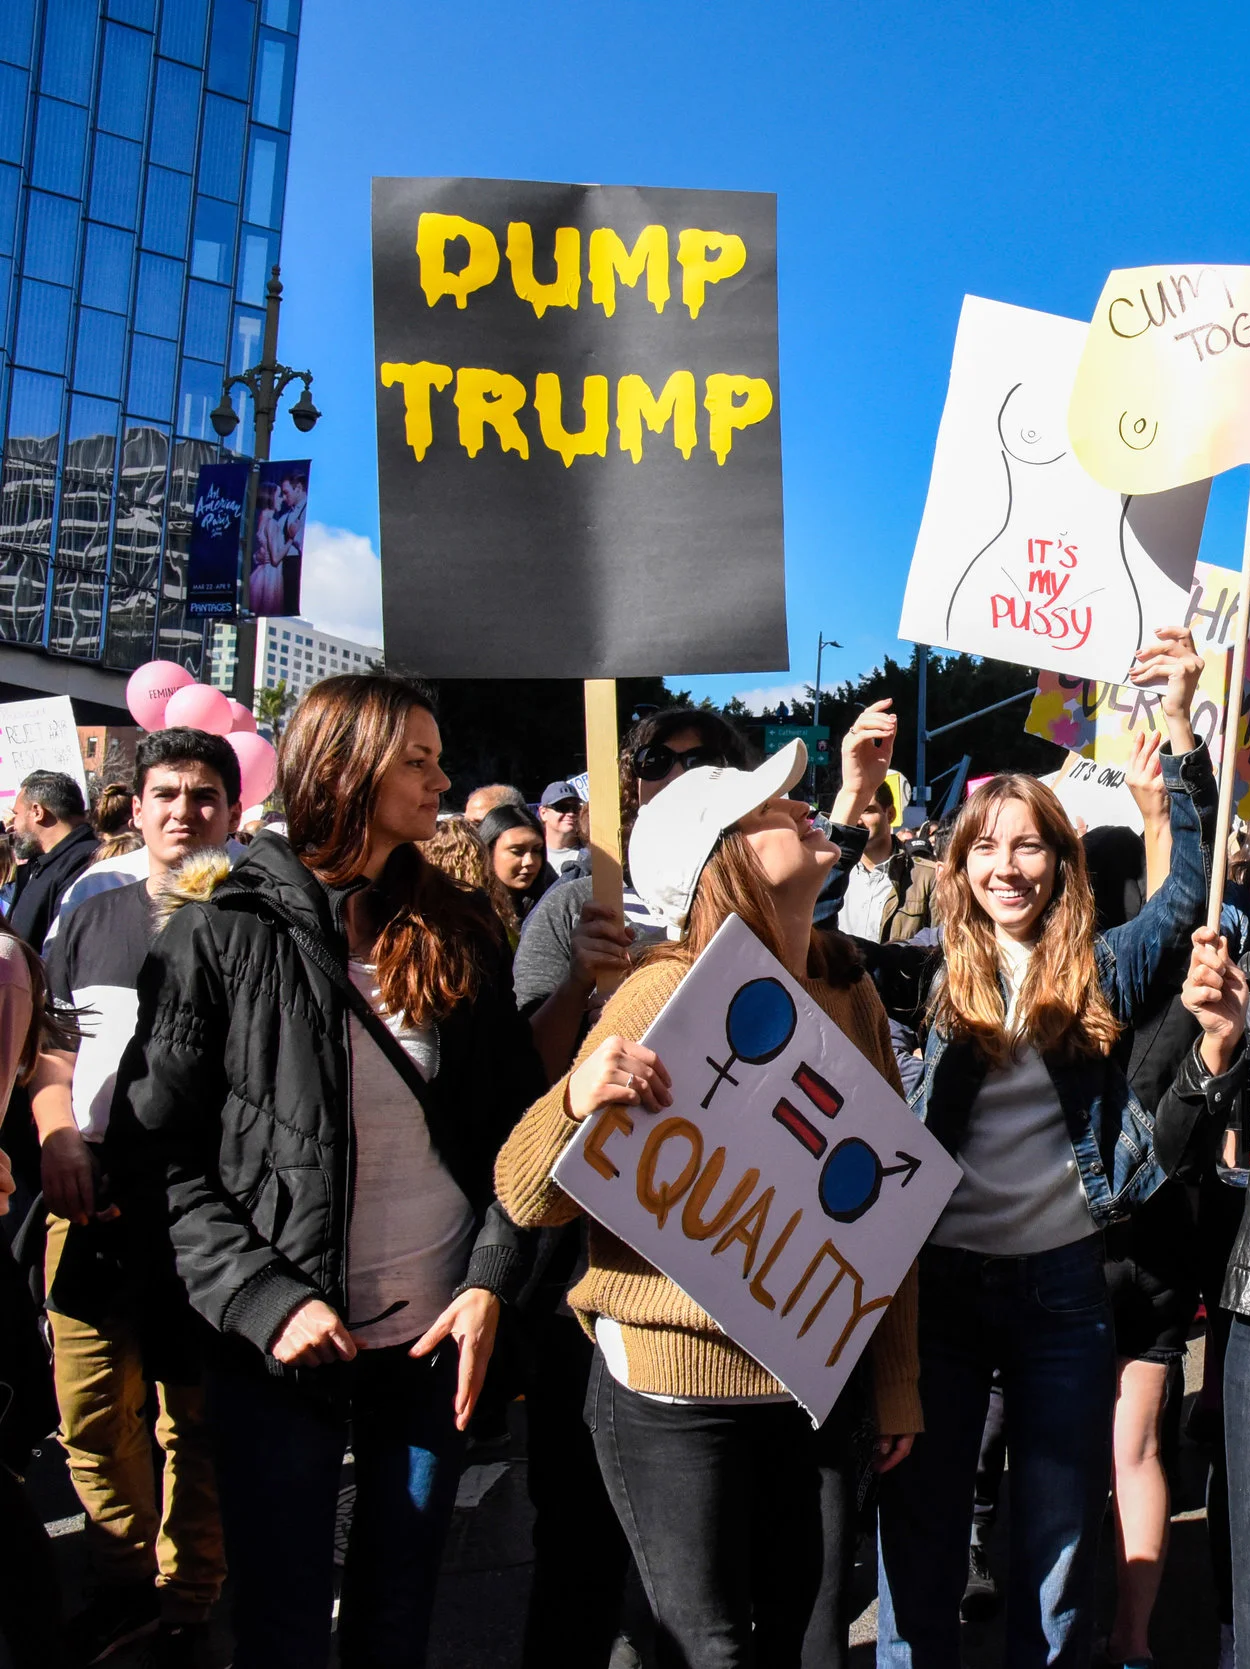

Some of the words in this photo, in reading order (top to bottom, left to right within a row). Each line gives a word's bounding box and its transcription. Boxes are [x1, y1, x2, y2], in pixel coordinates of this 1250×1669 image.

[416, 212, 746, 320] DUMP
[380, 361, 773, 468] TRUMP
[190, 602, 233, 612] PANTAGES
[582, 1104, 893, 1368] EQUALITY
